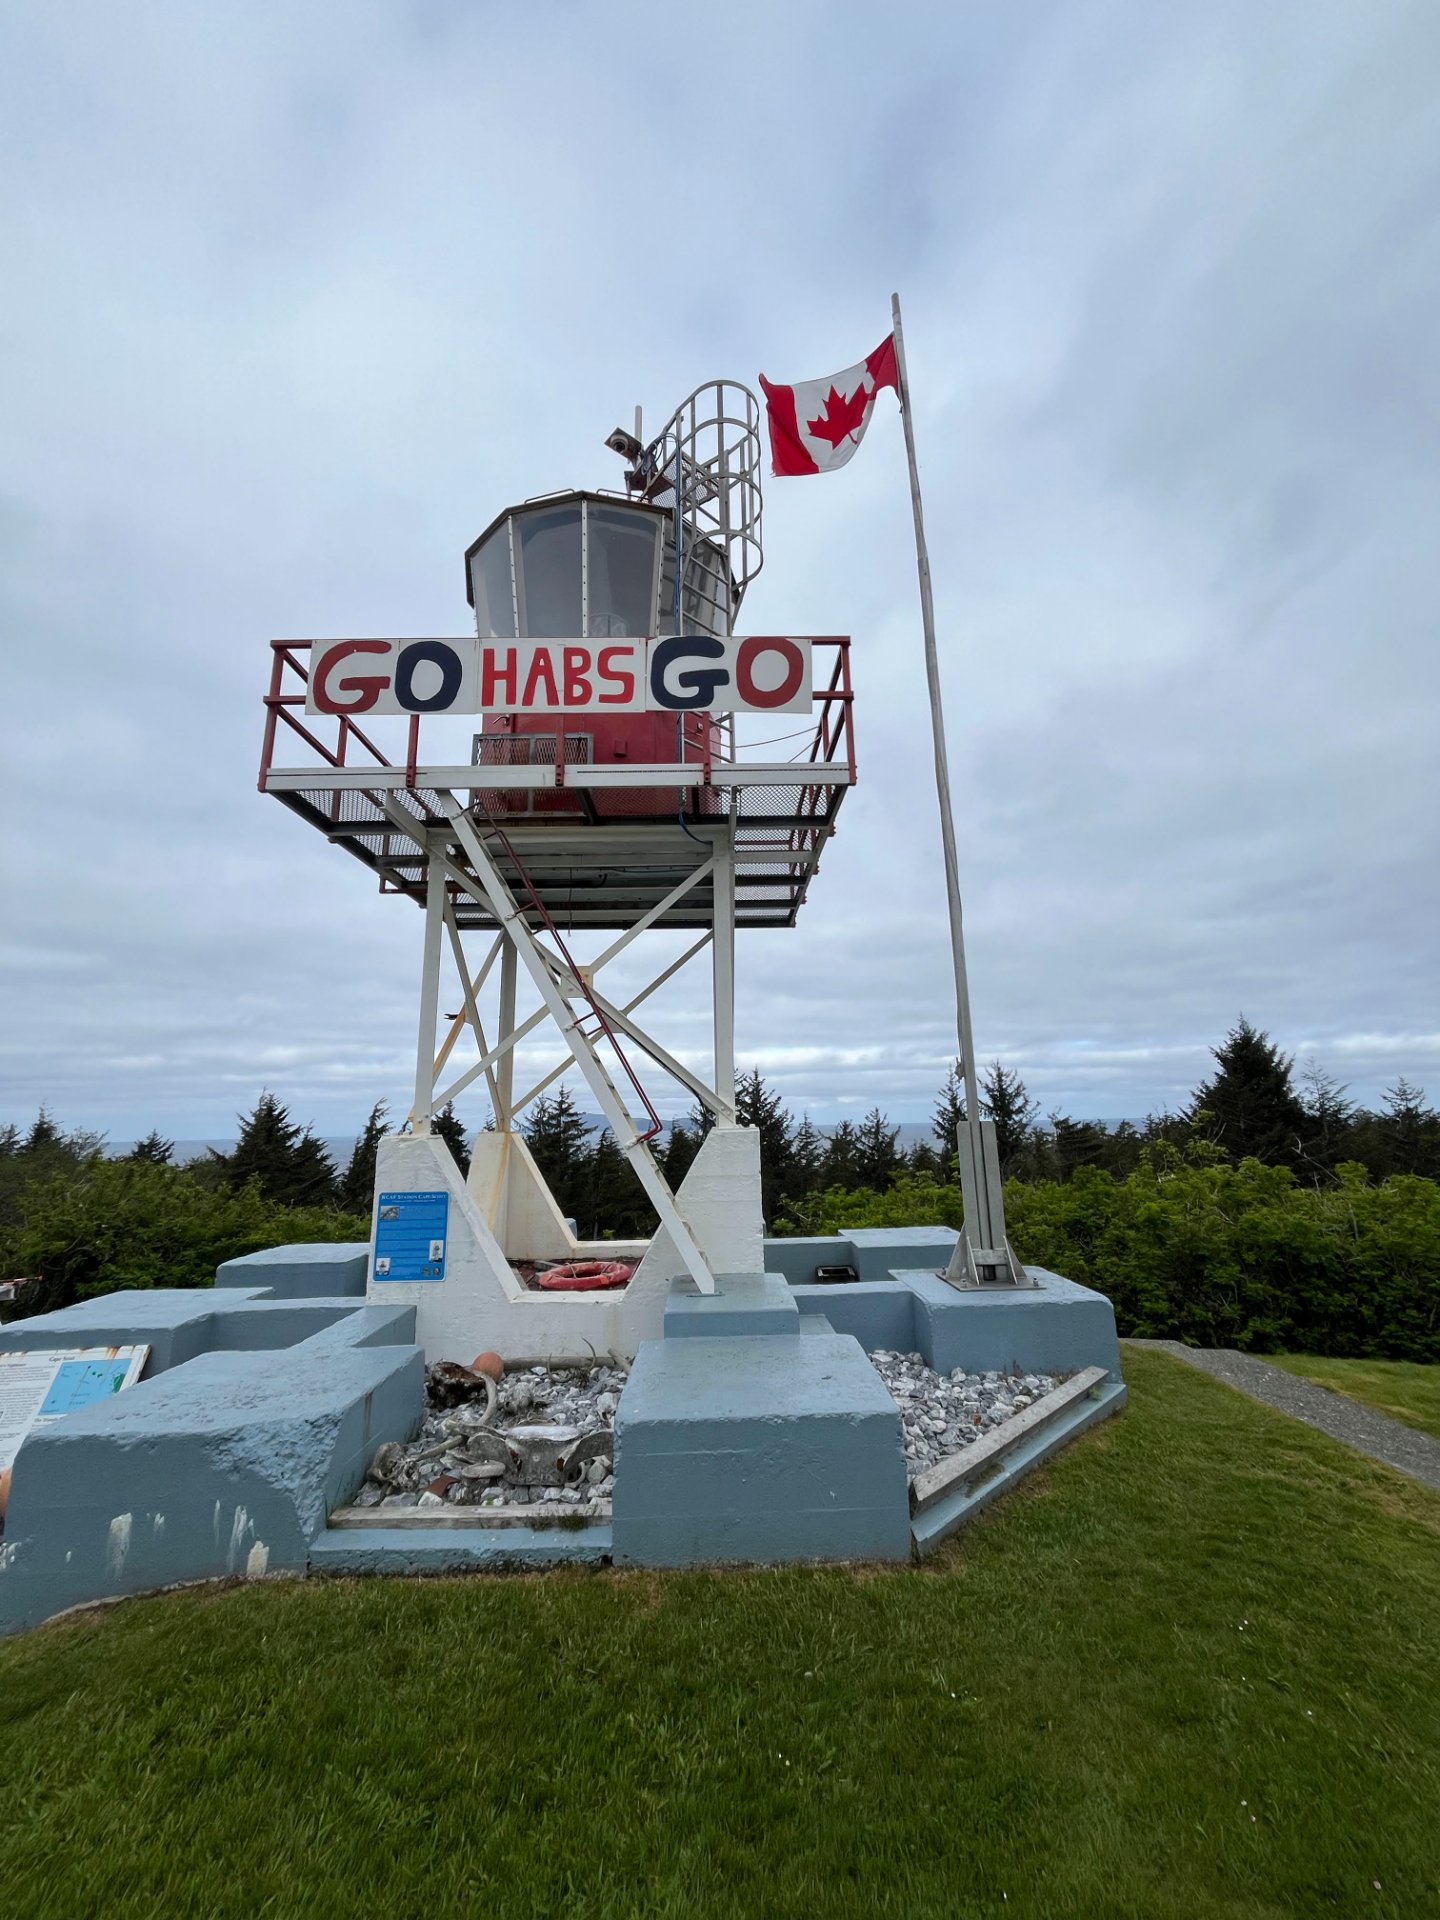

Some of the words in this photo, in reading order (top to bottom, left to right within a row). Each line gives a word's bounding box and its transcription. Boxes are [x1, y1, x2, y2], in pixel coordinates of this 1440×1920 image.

[313, 639, 463, 714] GO
[482, 646, 635, 707] HABS
[650, 635, 806, 710] GO
